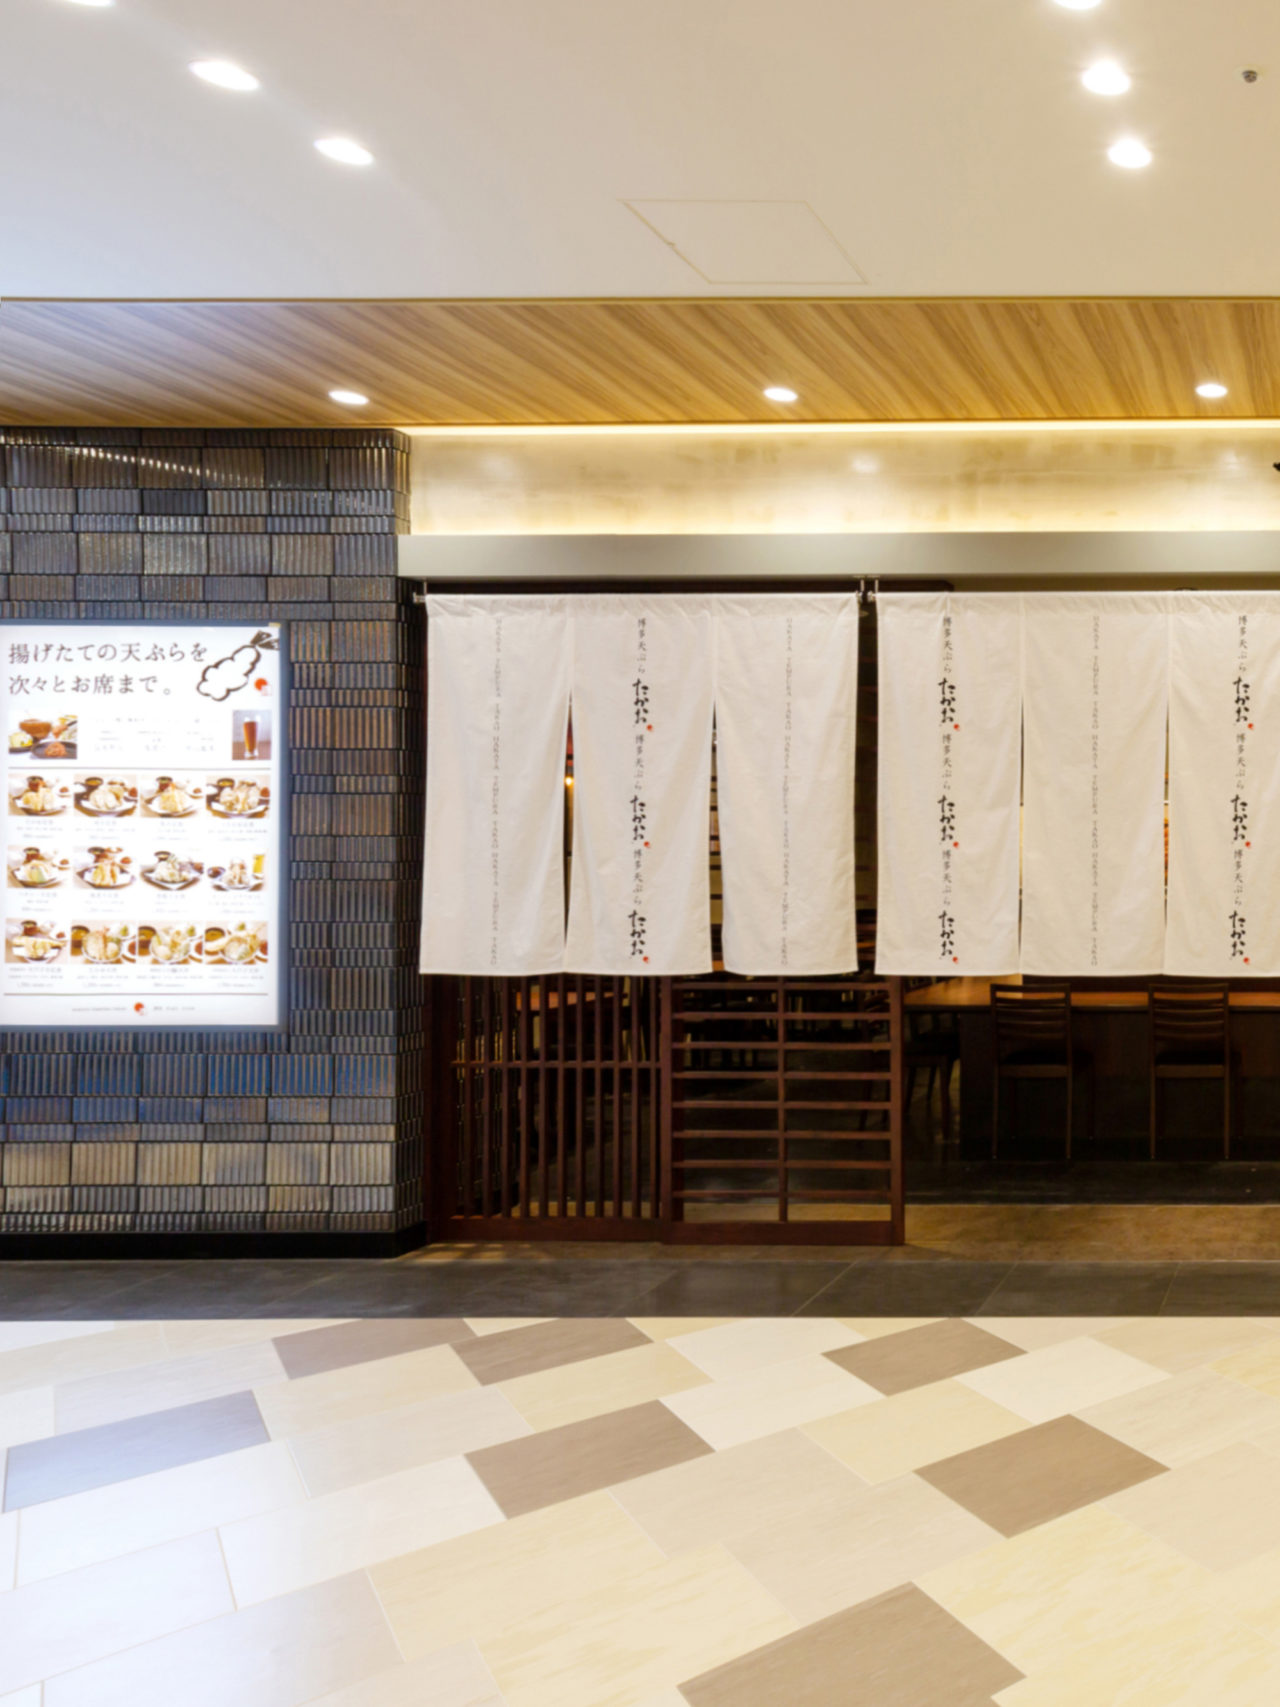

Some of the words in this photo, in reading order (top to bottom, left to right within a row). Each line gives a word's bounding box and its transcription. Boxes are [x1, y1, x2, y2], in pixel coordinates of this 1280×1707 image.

[9, 642, 208, 664] 揚げたての天ぷらを
[9, 674, 172, 695] 次々とお席まで。
[632, 678, 649, 724] たかお
[938, 677, 956, 723] たかお
[1232, 676, 1251, 724] たかお
[630, 795, 646, 841] たかお
[937, 795, 955, 841] たかお
[1230, 794, 1248, 841] たかお
[628, 910, 646, 956] たかお
[938, 910, 955, 956] たかお
[1228, 910, 1246, 957] たかお
